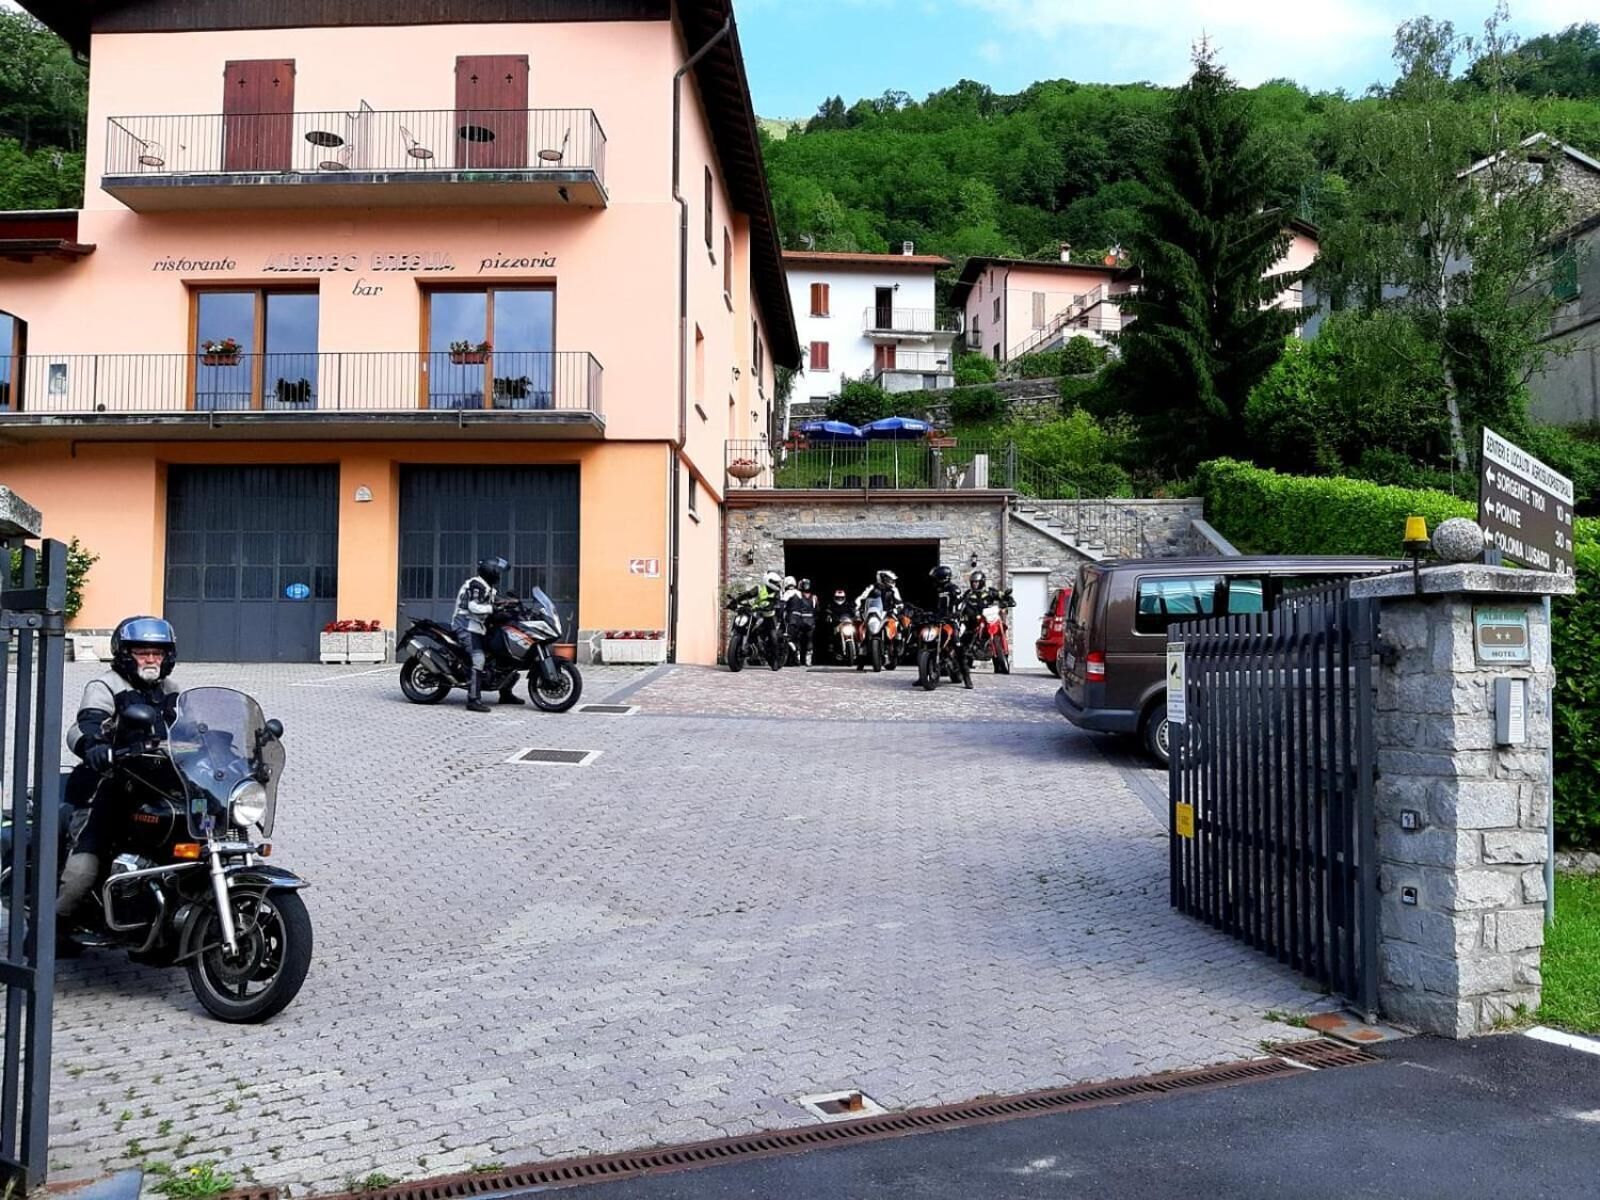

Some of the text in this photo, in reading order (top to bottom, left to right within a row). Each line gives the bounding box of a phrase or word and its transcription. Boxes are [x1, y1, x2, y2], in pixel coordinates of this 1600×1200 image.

[152, 255, 237, 272] ristorante
[262, 252, 456, 272] ALBERGO BREGLIA
[478, 251, 557, 274] pizzeria
[352, 277, 383, 296] bar
[1496, 471, 1531, 505] SORGENTE
[1556, 504, 1564, 522] 10
[1565, 512, 1572, 527] m
[1495, 501, 1573, 553] PONTE 30 m
[1494, 530, 1525, 560] COLONIA
[1491, 650, 1518, 658] HOTEL
